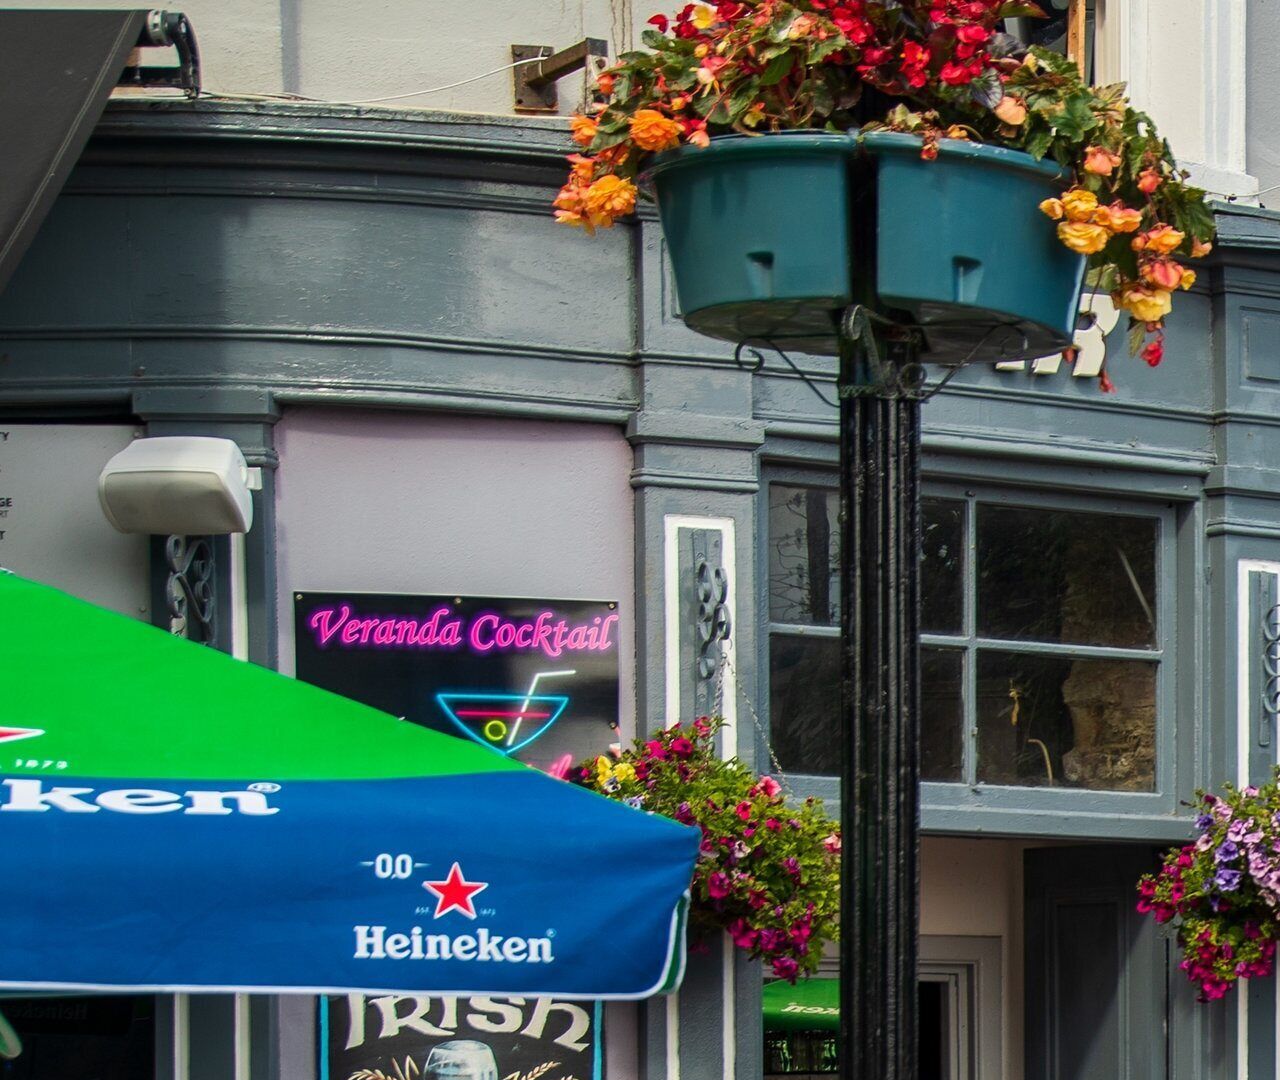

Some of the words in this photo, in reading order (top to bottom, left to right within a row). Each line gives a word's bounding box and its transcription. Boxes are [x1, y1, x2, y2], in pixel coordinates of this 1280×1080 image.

[311, 606, 462, 646] Veranda
[470, 611, 618, 656] Cocktail
[353, 925, 556, 963] Heineken
